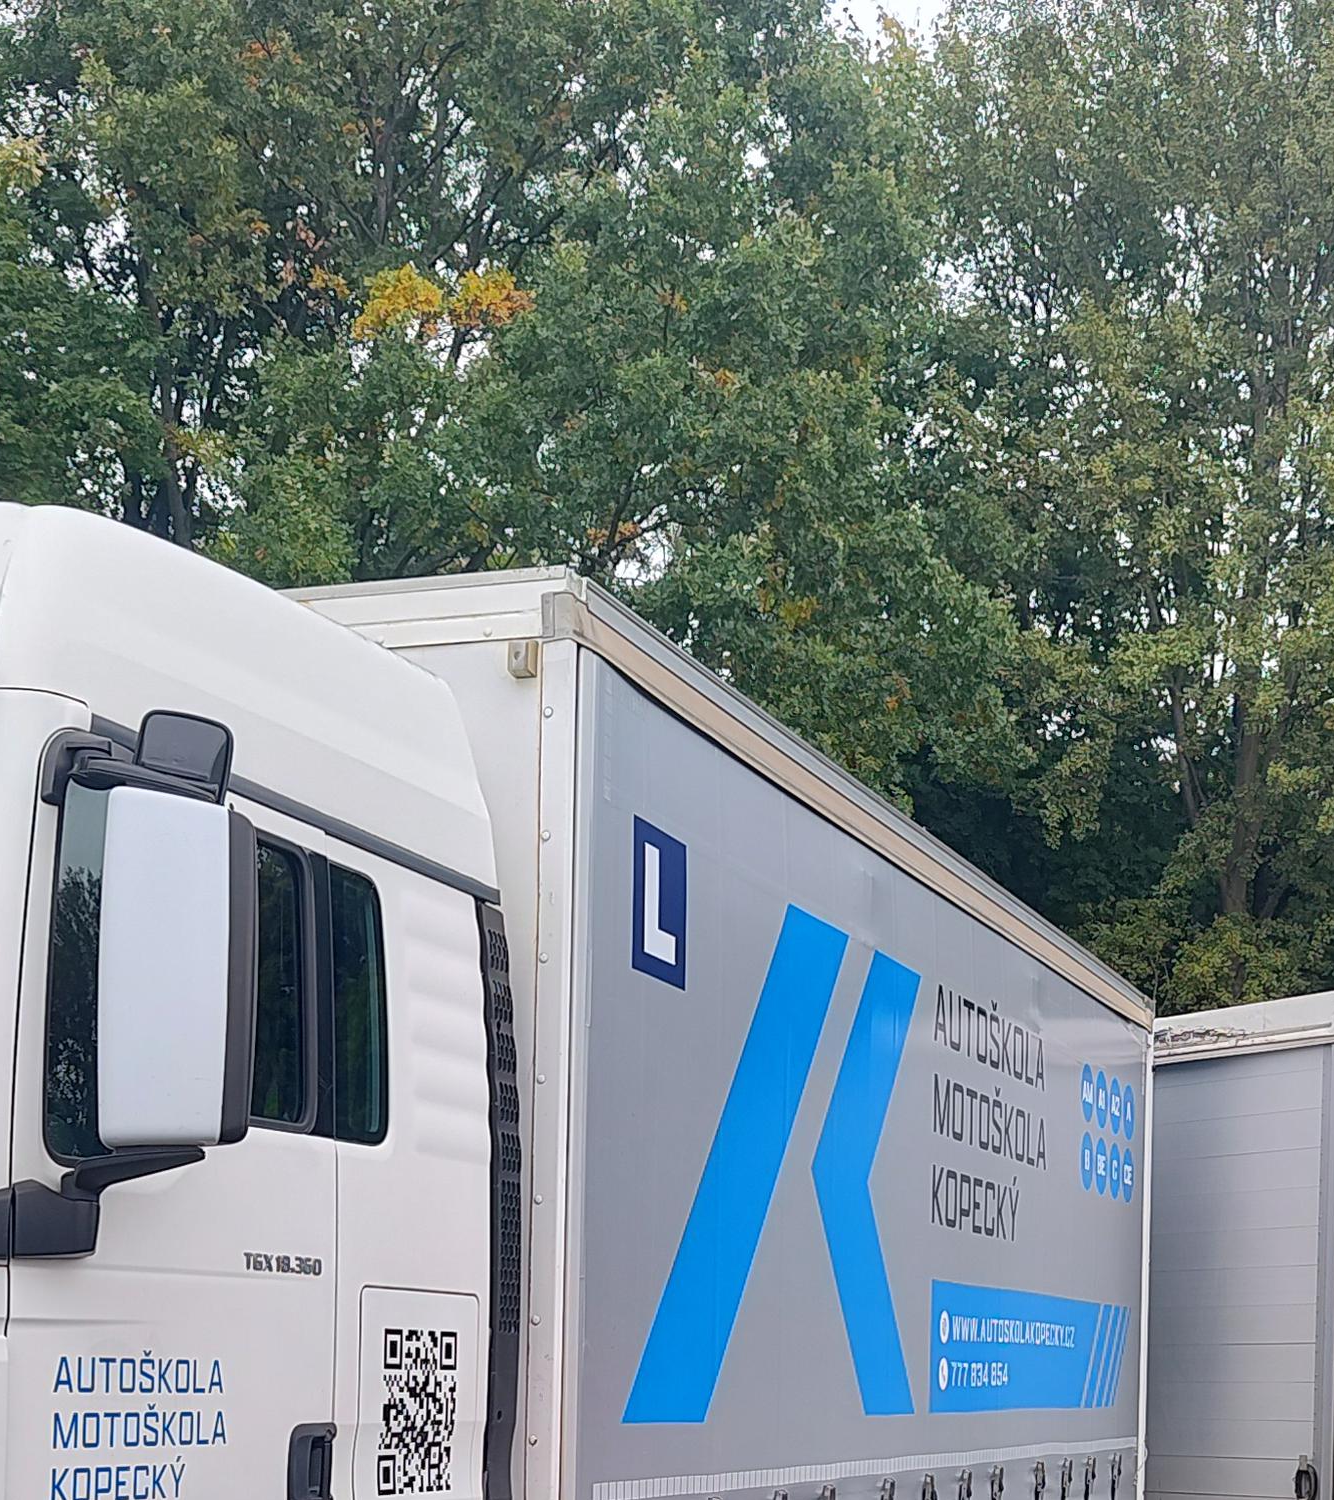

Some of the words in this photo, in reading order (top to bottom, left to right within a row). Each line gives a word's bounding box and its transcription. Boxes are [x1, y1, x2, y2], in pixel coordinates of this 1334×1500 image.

[643, 841, 677, 967] L
[933, 983, 1046, 1093] AUTOŠKOLA
[1082, 1080, 1094, 1105] AM
[1098, 1088, 1106, 1110] A1
[933, 1072, 1047, 1171] MOTOŠKOLA
[1097, 1154, 1106, 1177] BE
[931, 1163, 1020, 1242] KOPECKÝ
[243, 1252, 273, 1272] TGX
[951, 1315, 1075, 1349] WWW.AUTOSKOLAKOPECKY.CZ
[52, 1350, 224, 1395] AUTOŠKOLA
[951, 1361, 969, 1387] 777
[971, 1362, 989, 1387] 834
[991, 1363, 1009, 1386] 854
[51, 1403, 227, 1450] MOTOŠKOLA
